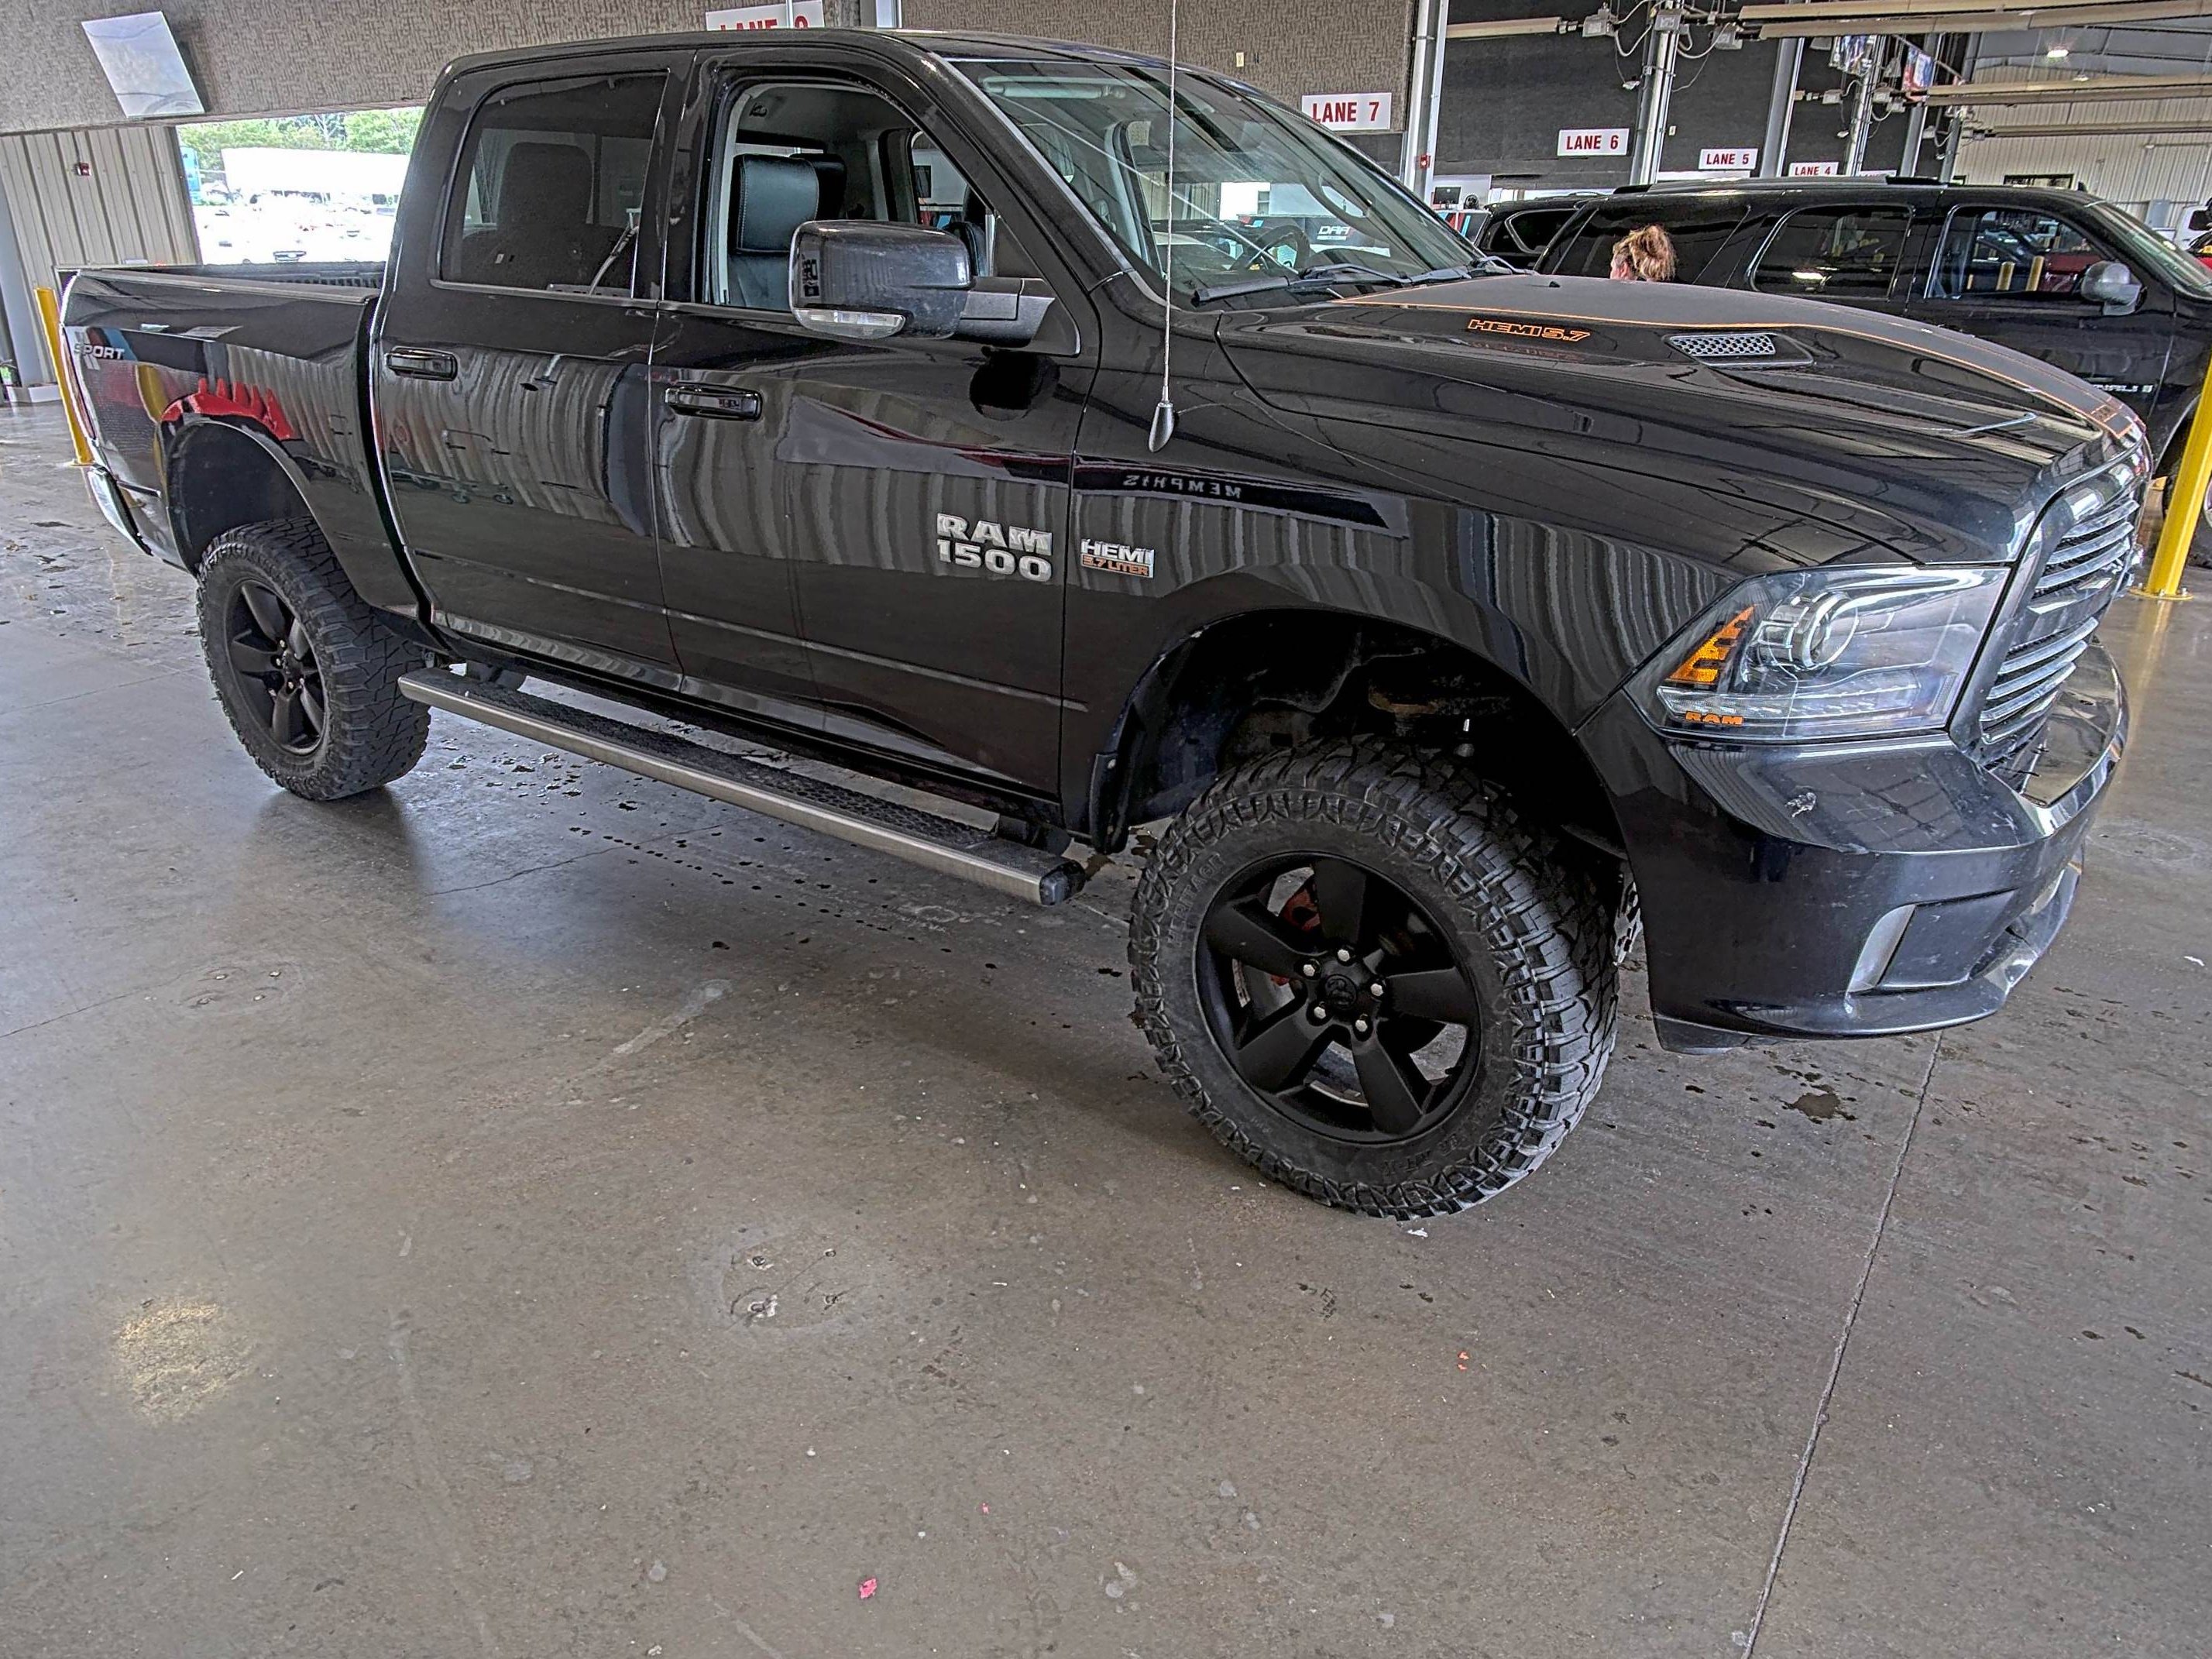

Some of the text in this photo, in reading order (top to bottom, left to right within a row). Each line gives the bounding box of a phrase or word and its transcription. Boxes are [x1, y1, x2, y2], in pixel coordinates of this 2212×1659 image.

[1313, 101, 1379, 122] LANE 7
[1566, 135, 1619, 150] LANE 6
[1706, 153, 1750, 165] LANE 5
[1794, 166, 1831, 176] LANE 4
[1468, 319, 1591, 342] HEMI 5.7
[74, 342, 125, 359] SPORT
[937, 513, 1053, 556] RAM
[1080, 538, 1155, 565] HEMI
[937, 539, 1052, 582] 1500
[1108, 560, 1149, 575] LITER
[1685, 711, 1743, 725] RAM
